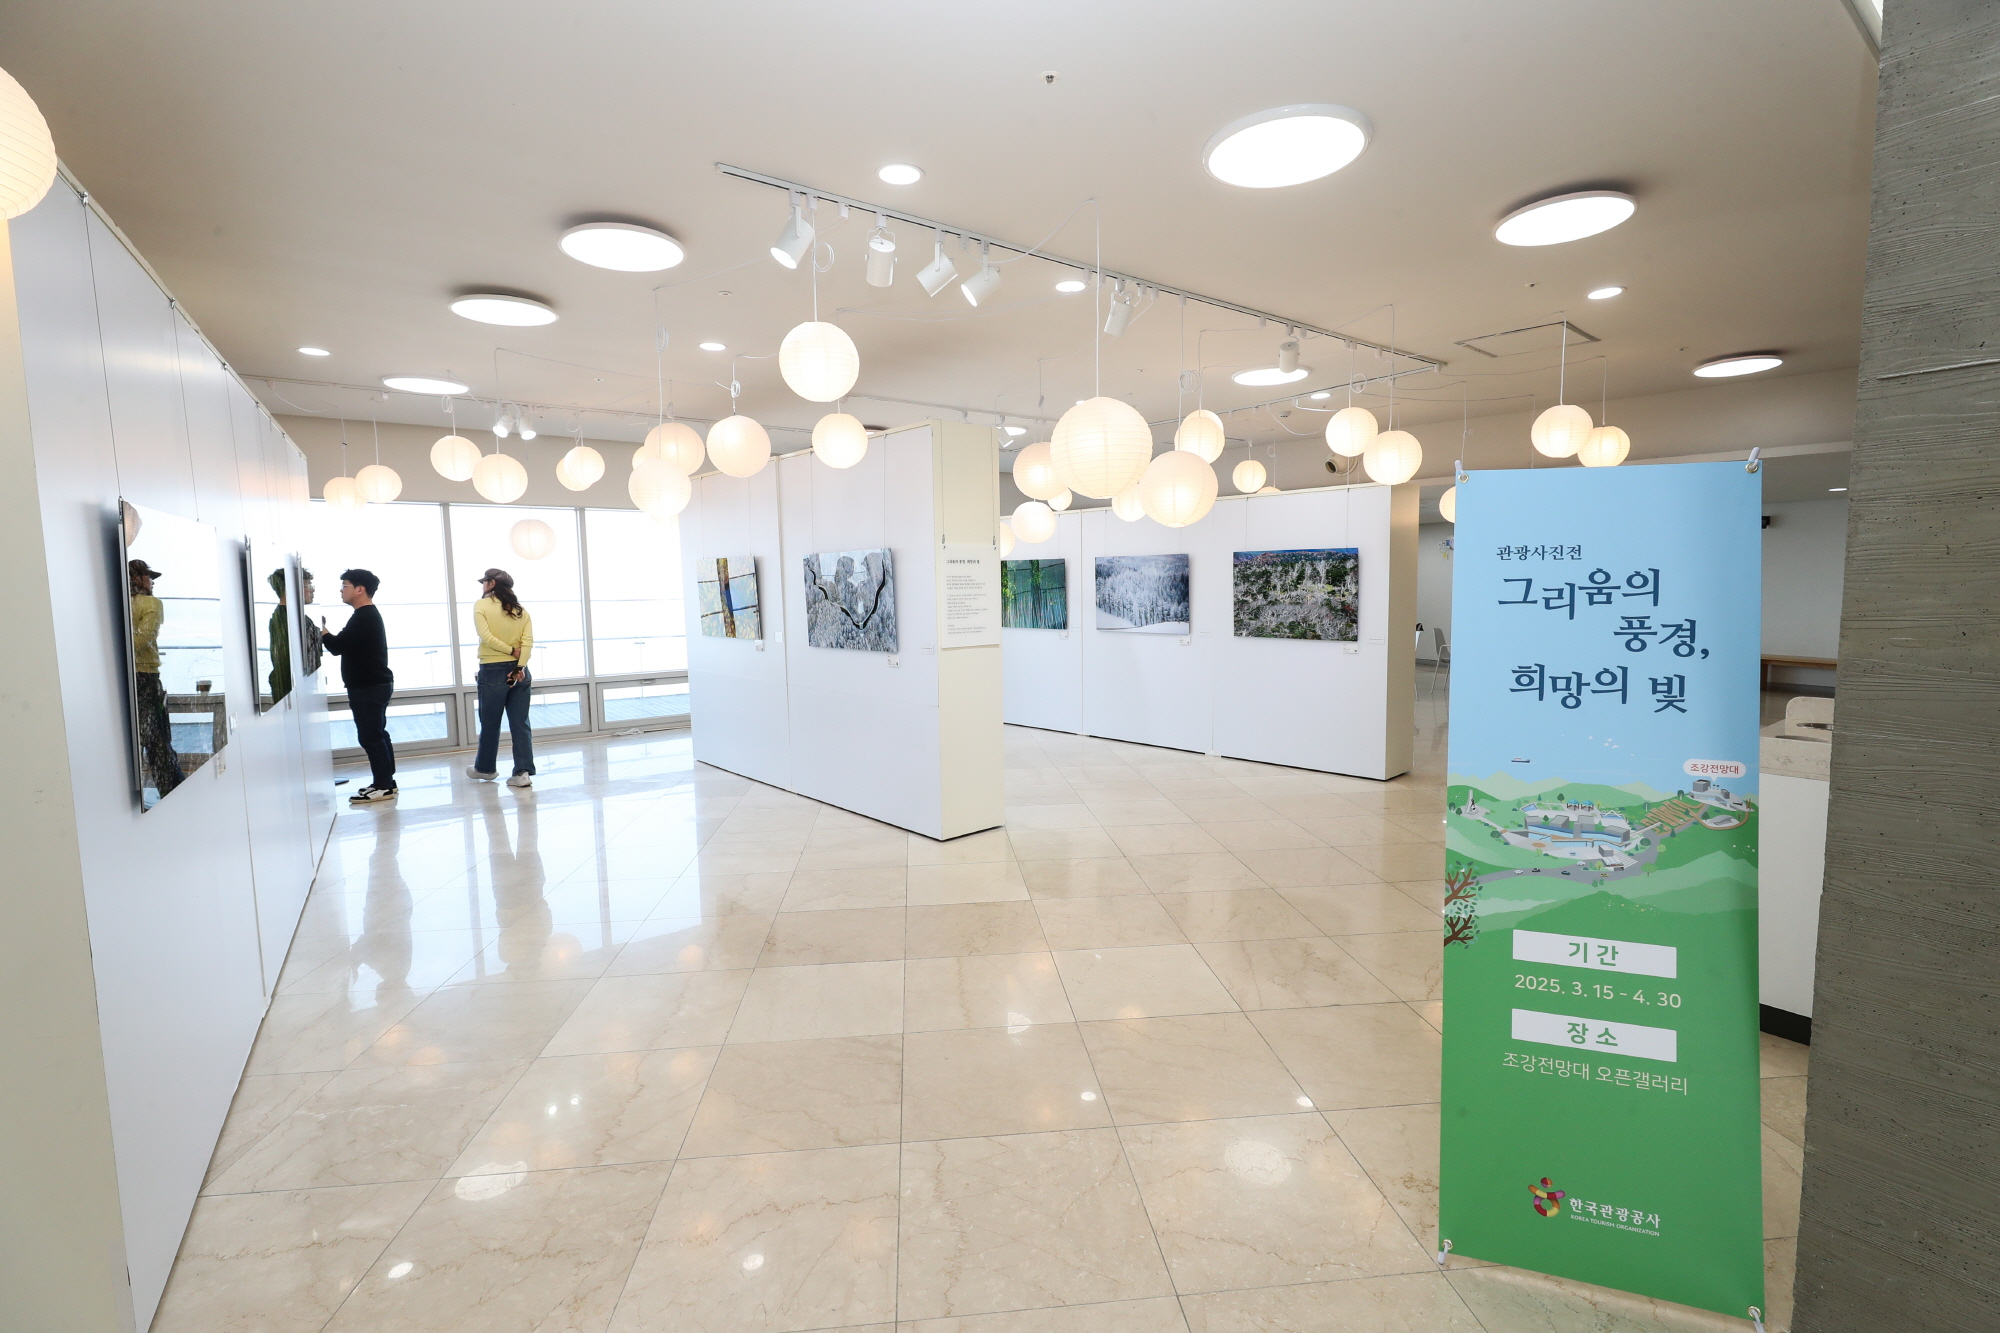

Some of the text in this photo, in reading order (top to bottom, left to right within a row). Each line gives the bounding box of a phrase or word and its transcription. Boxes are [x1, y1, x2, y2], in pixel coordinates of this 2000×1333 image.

[1496, 544, 1582, 561] 관광사진전
[1498, 568, 1661, 620] 그리움의
[1613, 615, 1710, 659] 풍경,
[1509, 663, 1688, 713] 희망의 빛
[1690, 763, 1739, 775] 조강전망대
[1514, 974, 1566, 995] 2025.
[1571, 981, 1588, 998] 3.
[1593, 984, 1614, 1000] 15
[1633, 989, 1650, 1006] 4.
[1657, 992, 1682, 1009] 30
[1502, 1052, 1688, 1096] 조강전망대 오픈갤러리
[1569, 1198, 1660, 1228] 한국관광공사
[1571, 1214, 1659, 1236] KOREA TOURISM ORGANIZATION
